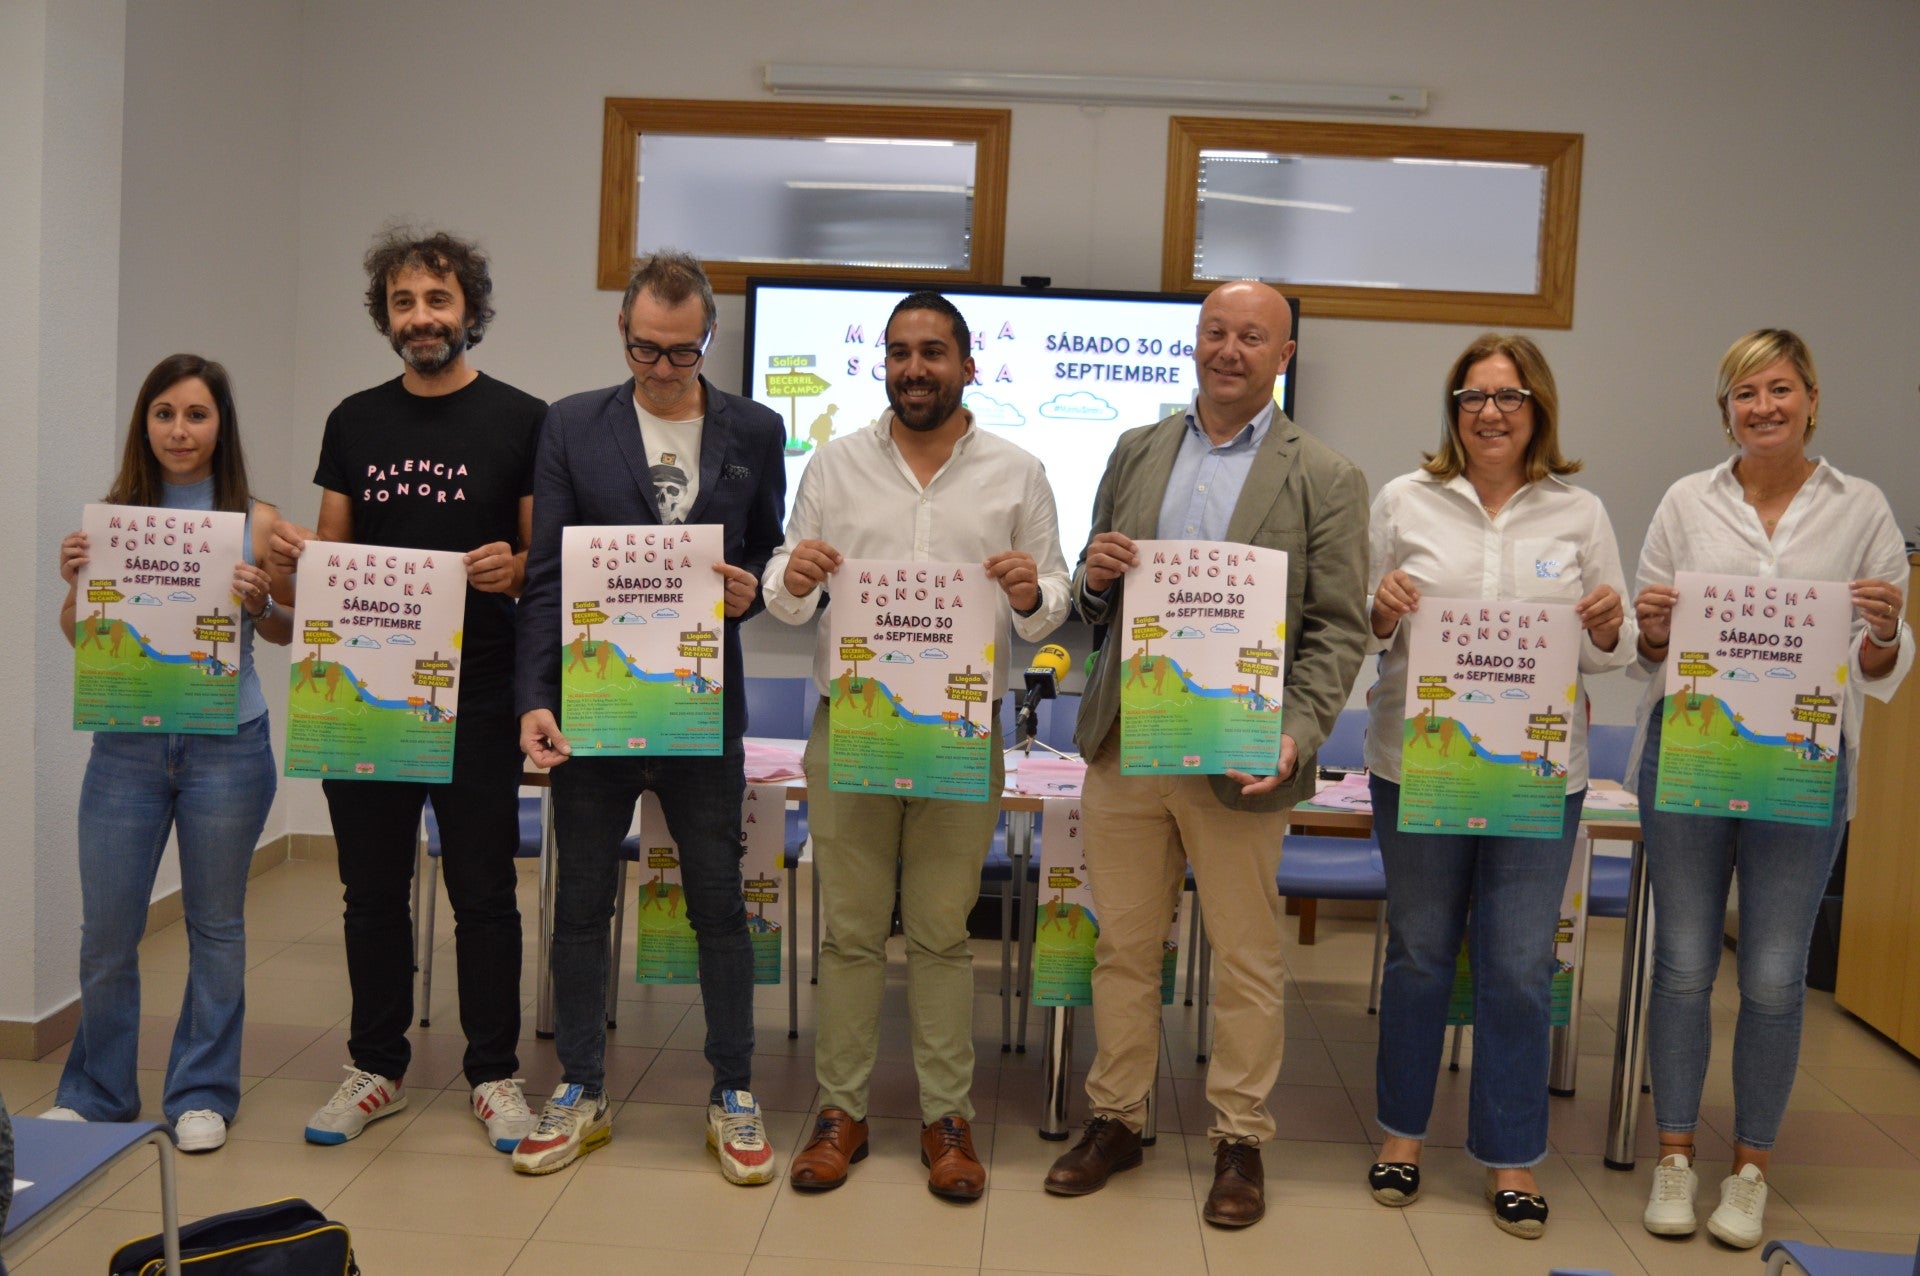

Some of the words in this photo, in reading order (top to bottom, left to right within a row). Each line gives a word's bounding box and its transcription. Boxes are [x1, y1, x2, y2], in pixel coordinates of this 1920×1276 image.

[845, 321, 1015, 350] MAHA
[1046, 332, 1130, 354] SÁBADO
[1138, 338, 1162, 356] 30
[1170, 340, 1194, 357] de
[772, 356, 808, 367] Salida
[848, 356, 1012, 385] SORA
[770, 376, 814, 385] BECERRIL
[1055, 362, 1180, 384] SEPTIEMBRE
[770, 386, 782, 395] de
[784, 386, 824, 395] CAMPOS
[368, 460, 468, 481] PALENCIA
[364, 483, 465, 502] SONORA
[109, 515, 213, 534] MARCHA
[110, 533, 210, 554] SONORA
[590, 530, 691, 550] MARCHA
[126, 556, 180, 572] SÁBADO
[184, 562, 200, 573] 30
[328, 554, 435, 574] MARCHA
[592, 550, 692, 570] SONORA
[1153, 548, 1256, 566] MARCHA
[123, 576, 133, 584] de
[135, 575, 200, 587] SEPTIEMBRE
[328, 573, 432, 596] SONORA
[607, 575, 662, 589] SÁBADO
[666, 577, 682, 588] 30
[859, 569, 964, 587] MARCHA
[1155, 566, 1255, 587] SONORA
[618, 594, 684, 603] SEPTIEMBRE
[861, 588, 963, 609] SONORA
[1168, 590, 1223, 604] SÁBADO
[1228, 594, 1245, 604] 30
[1704, 585, 1817, 606] MARCHA
[343, 597, 400, 613] SÁBADO
[404, 604, 421, 615] 30
[1178, 608, 1245, 619] SEPTIEMBRE
[340, 617, 350, 625] de
[352, 616, 421, 630] SEPTIEMBRE
[876, 612, 932, 627] SÁBADO
[936, 617, 952, 628] 30
[1441, 608, 1548, 628] MARCHA
[1704, 604, 1815, 628] SONORA
[886, 632, 953, 643] SEPTIEMBRE
[1442, 627, 1546, 650] SONORA
[1720, 628, 1780, 646] SÁBADO
[1785, 635, 1803, 648] 30
[1457, 652, 1514, 668] SÁBADO
[1518, 657, 1535, 669] 30
[1716, 649, 1727, 657] de
[1730, 648, 1803, 663] SEPTIEMBRE
[1454, 672, 1464, 680] de
[1467, 671, 1535, 684] SEPTIEMBRE
